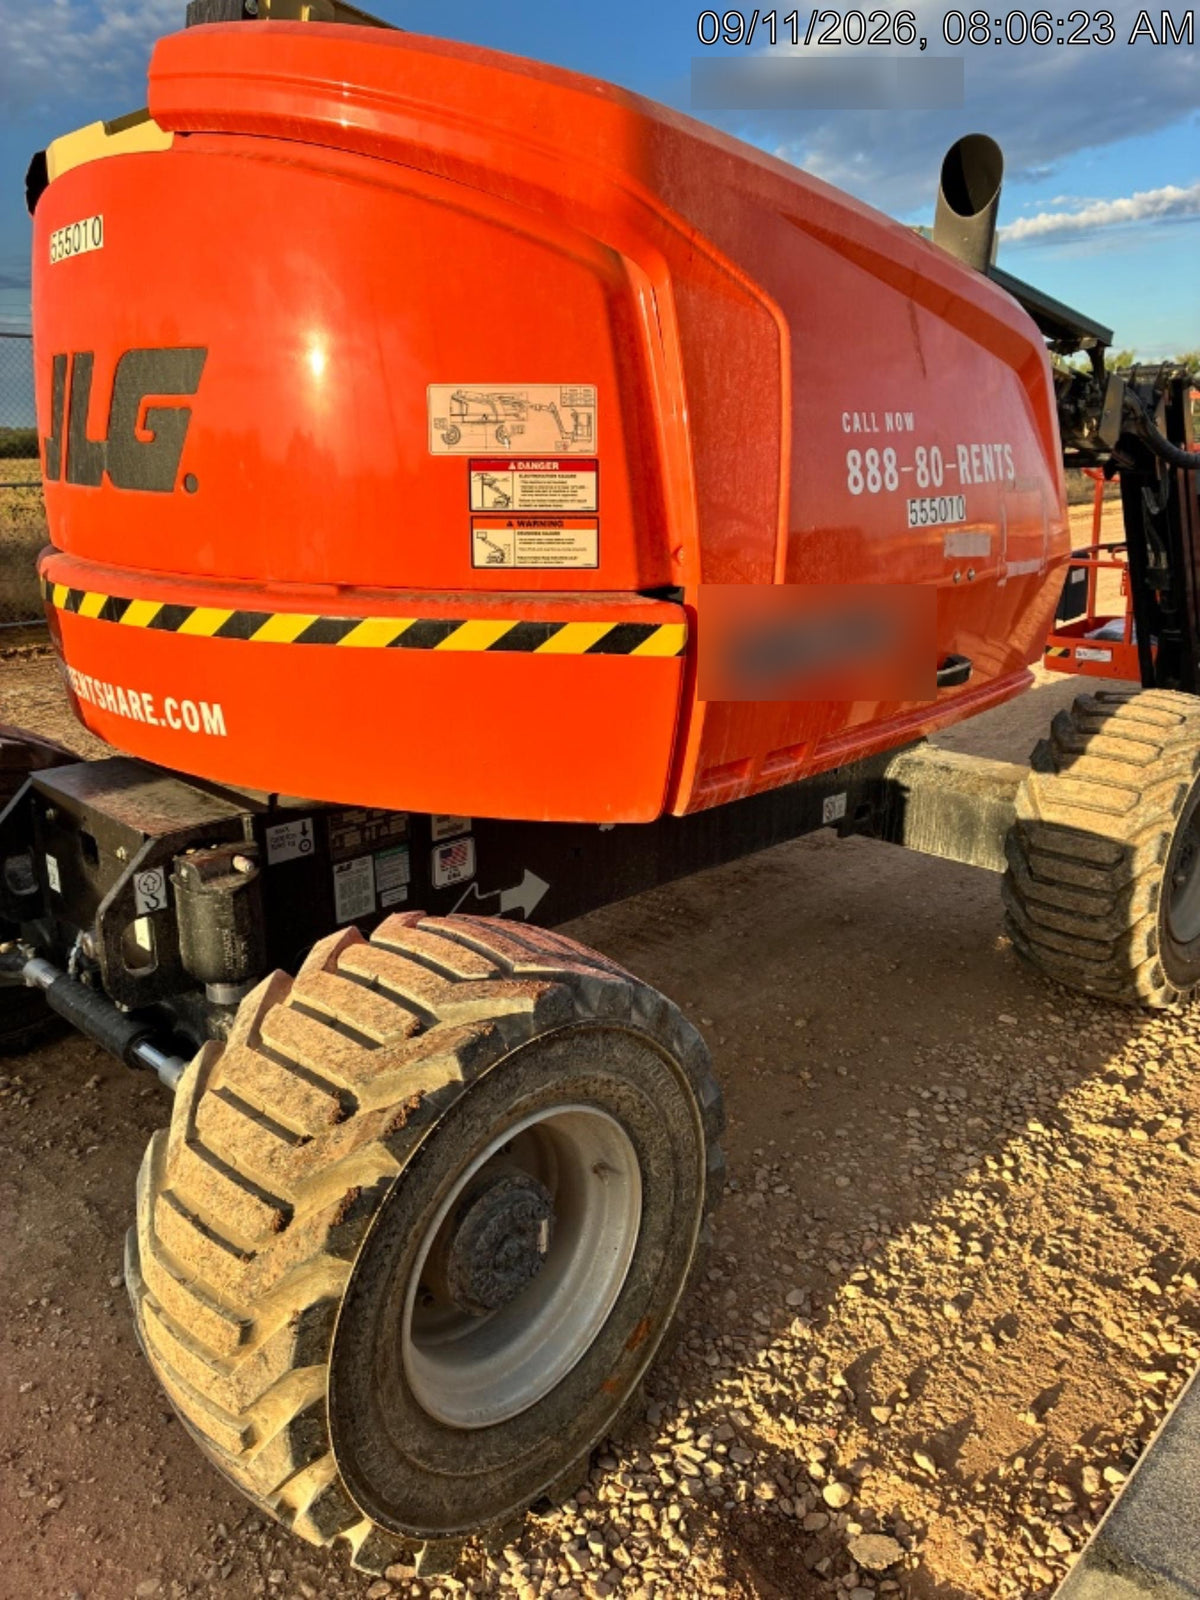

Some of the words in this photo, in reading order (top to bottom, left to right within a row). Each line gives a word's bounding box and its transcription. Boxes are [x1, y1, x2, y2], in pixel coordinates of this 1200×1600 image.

[50, 215, 102, 262] 555010
[842, 412, 880, 433] CALL
[886, 411, 915, 432] NOW
[517, 461, 560, 470] DANGER
[846, 443, 1016, 496] 888-80-RENTS
[908, 495, 966, 526] 555010
[516, 520, 565, 528] WARNING
